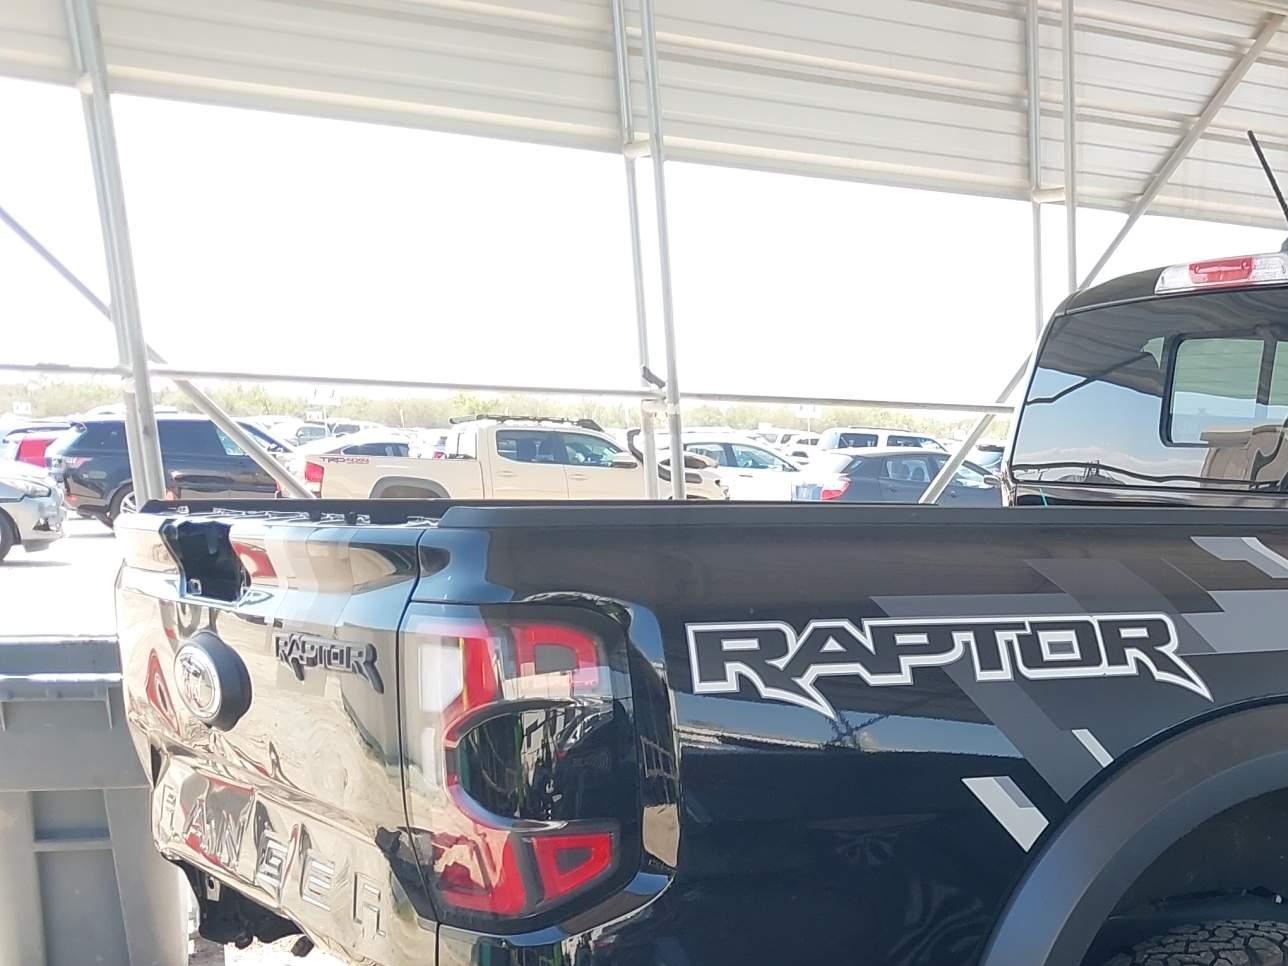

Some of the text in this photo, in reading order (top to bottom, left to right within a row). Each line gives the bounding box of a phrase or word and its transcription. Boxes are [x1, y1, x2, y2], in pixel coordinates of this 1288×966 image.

[319, 456, 346, 464] TRD
[273, 633, 385, 695] RAPTOR
[685, 613, 1215, 721] RAPTOR
